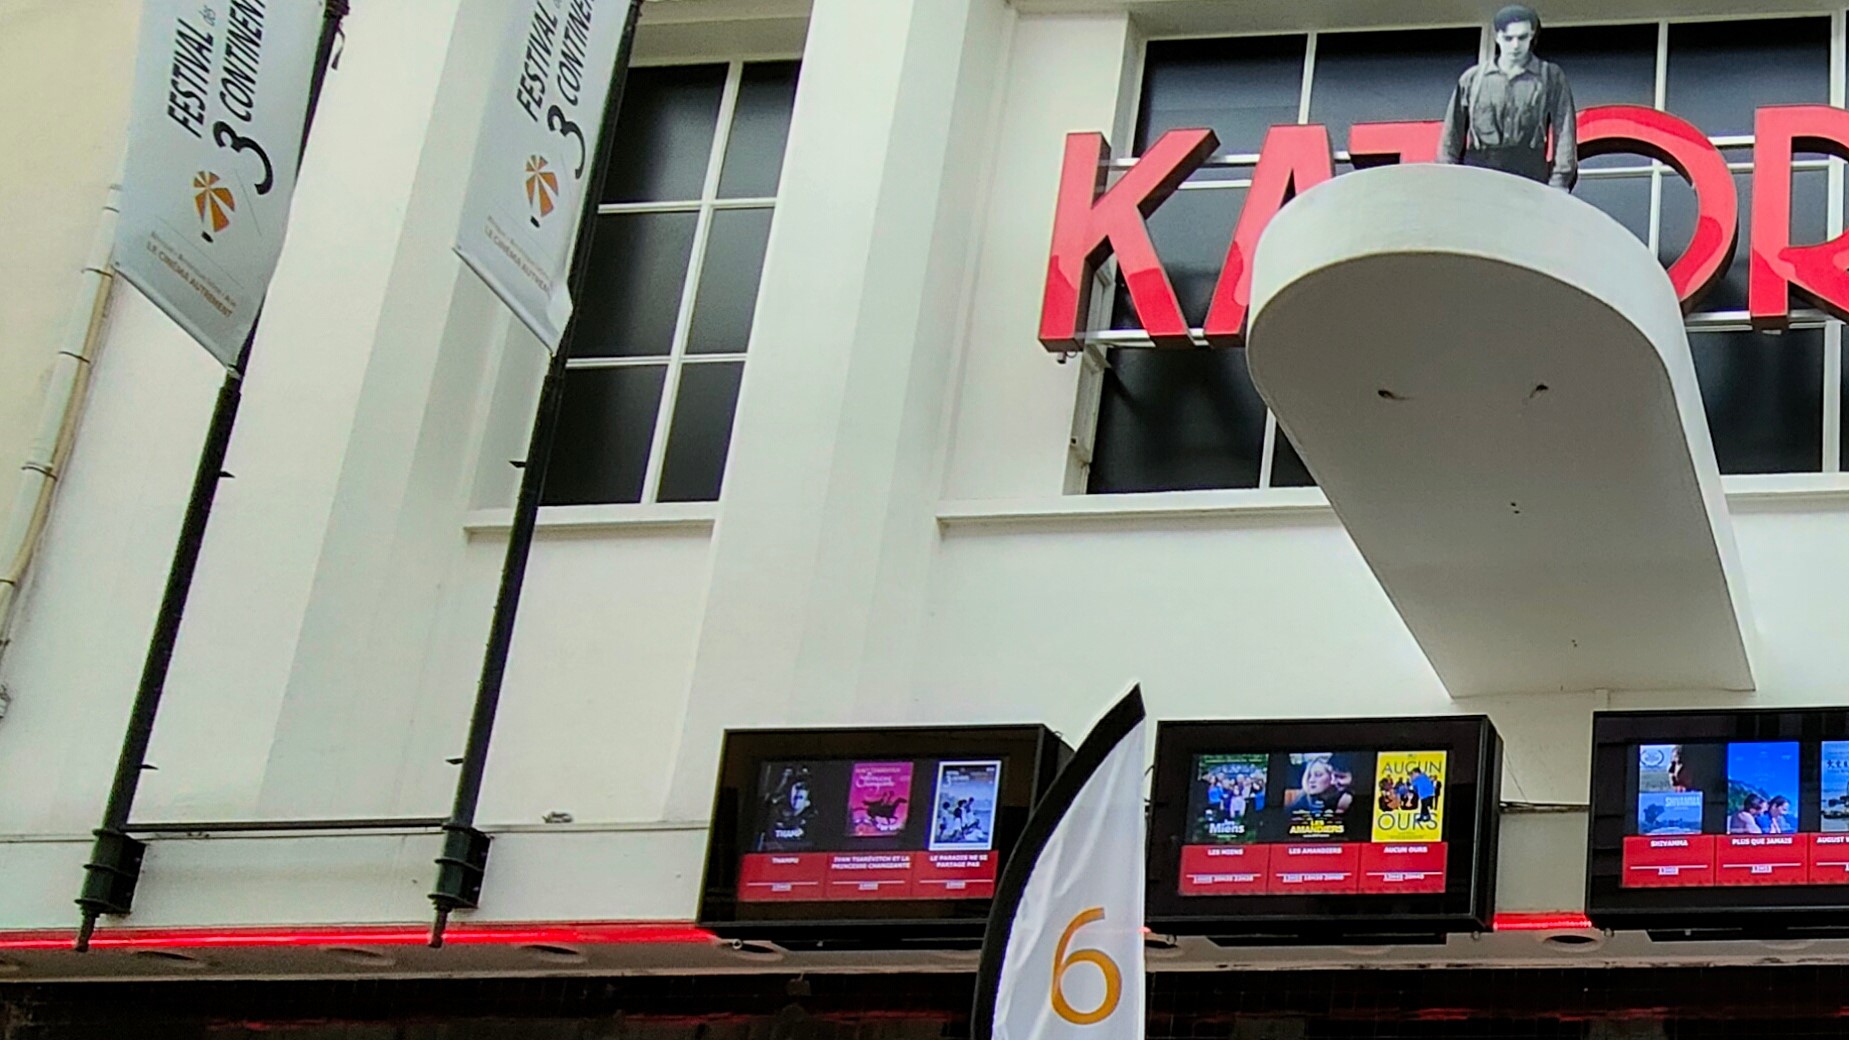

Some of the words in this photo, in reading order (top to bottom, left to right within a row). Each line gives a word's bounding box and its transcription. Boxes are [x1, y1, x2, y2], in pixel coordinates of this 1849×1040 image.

[168, 18, 214, 138] FESTIVAL
[547, 104, 586, 179] 3
[212, 121, 273, 195] 3
[1382, 761, 1442, 775] AUCUN
[1209, 823, 1245, 834] Miens
[1289, 824, 1344, 834] AMANDIERS
[1377, 813, 1438, 831] OURS
[1766, 837, 1792, 845] JAMAIS
[1301, 847, 1343, 855] AMANDIERS
[1051, 906, 1122, 1025] 6
